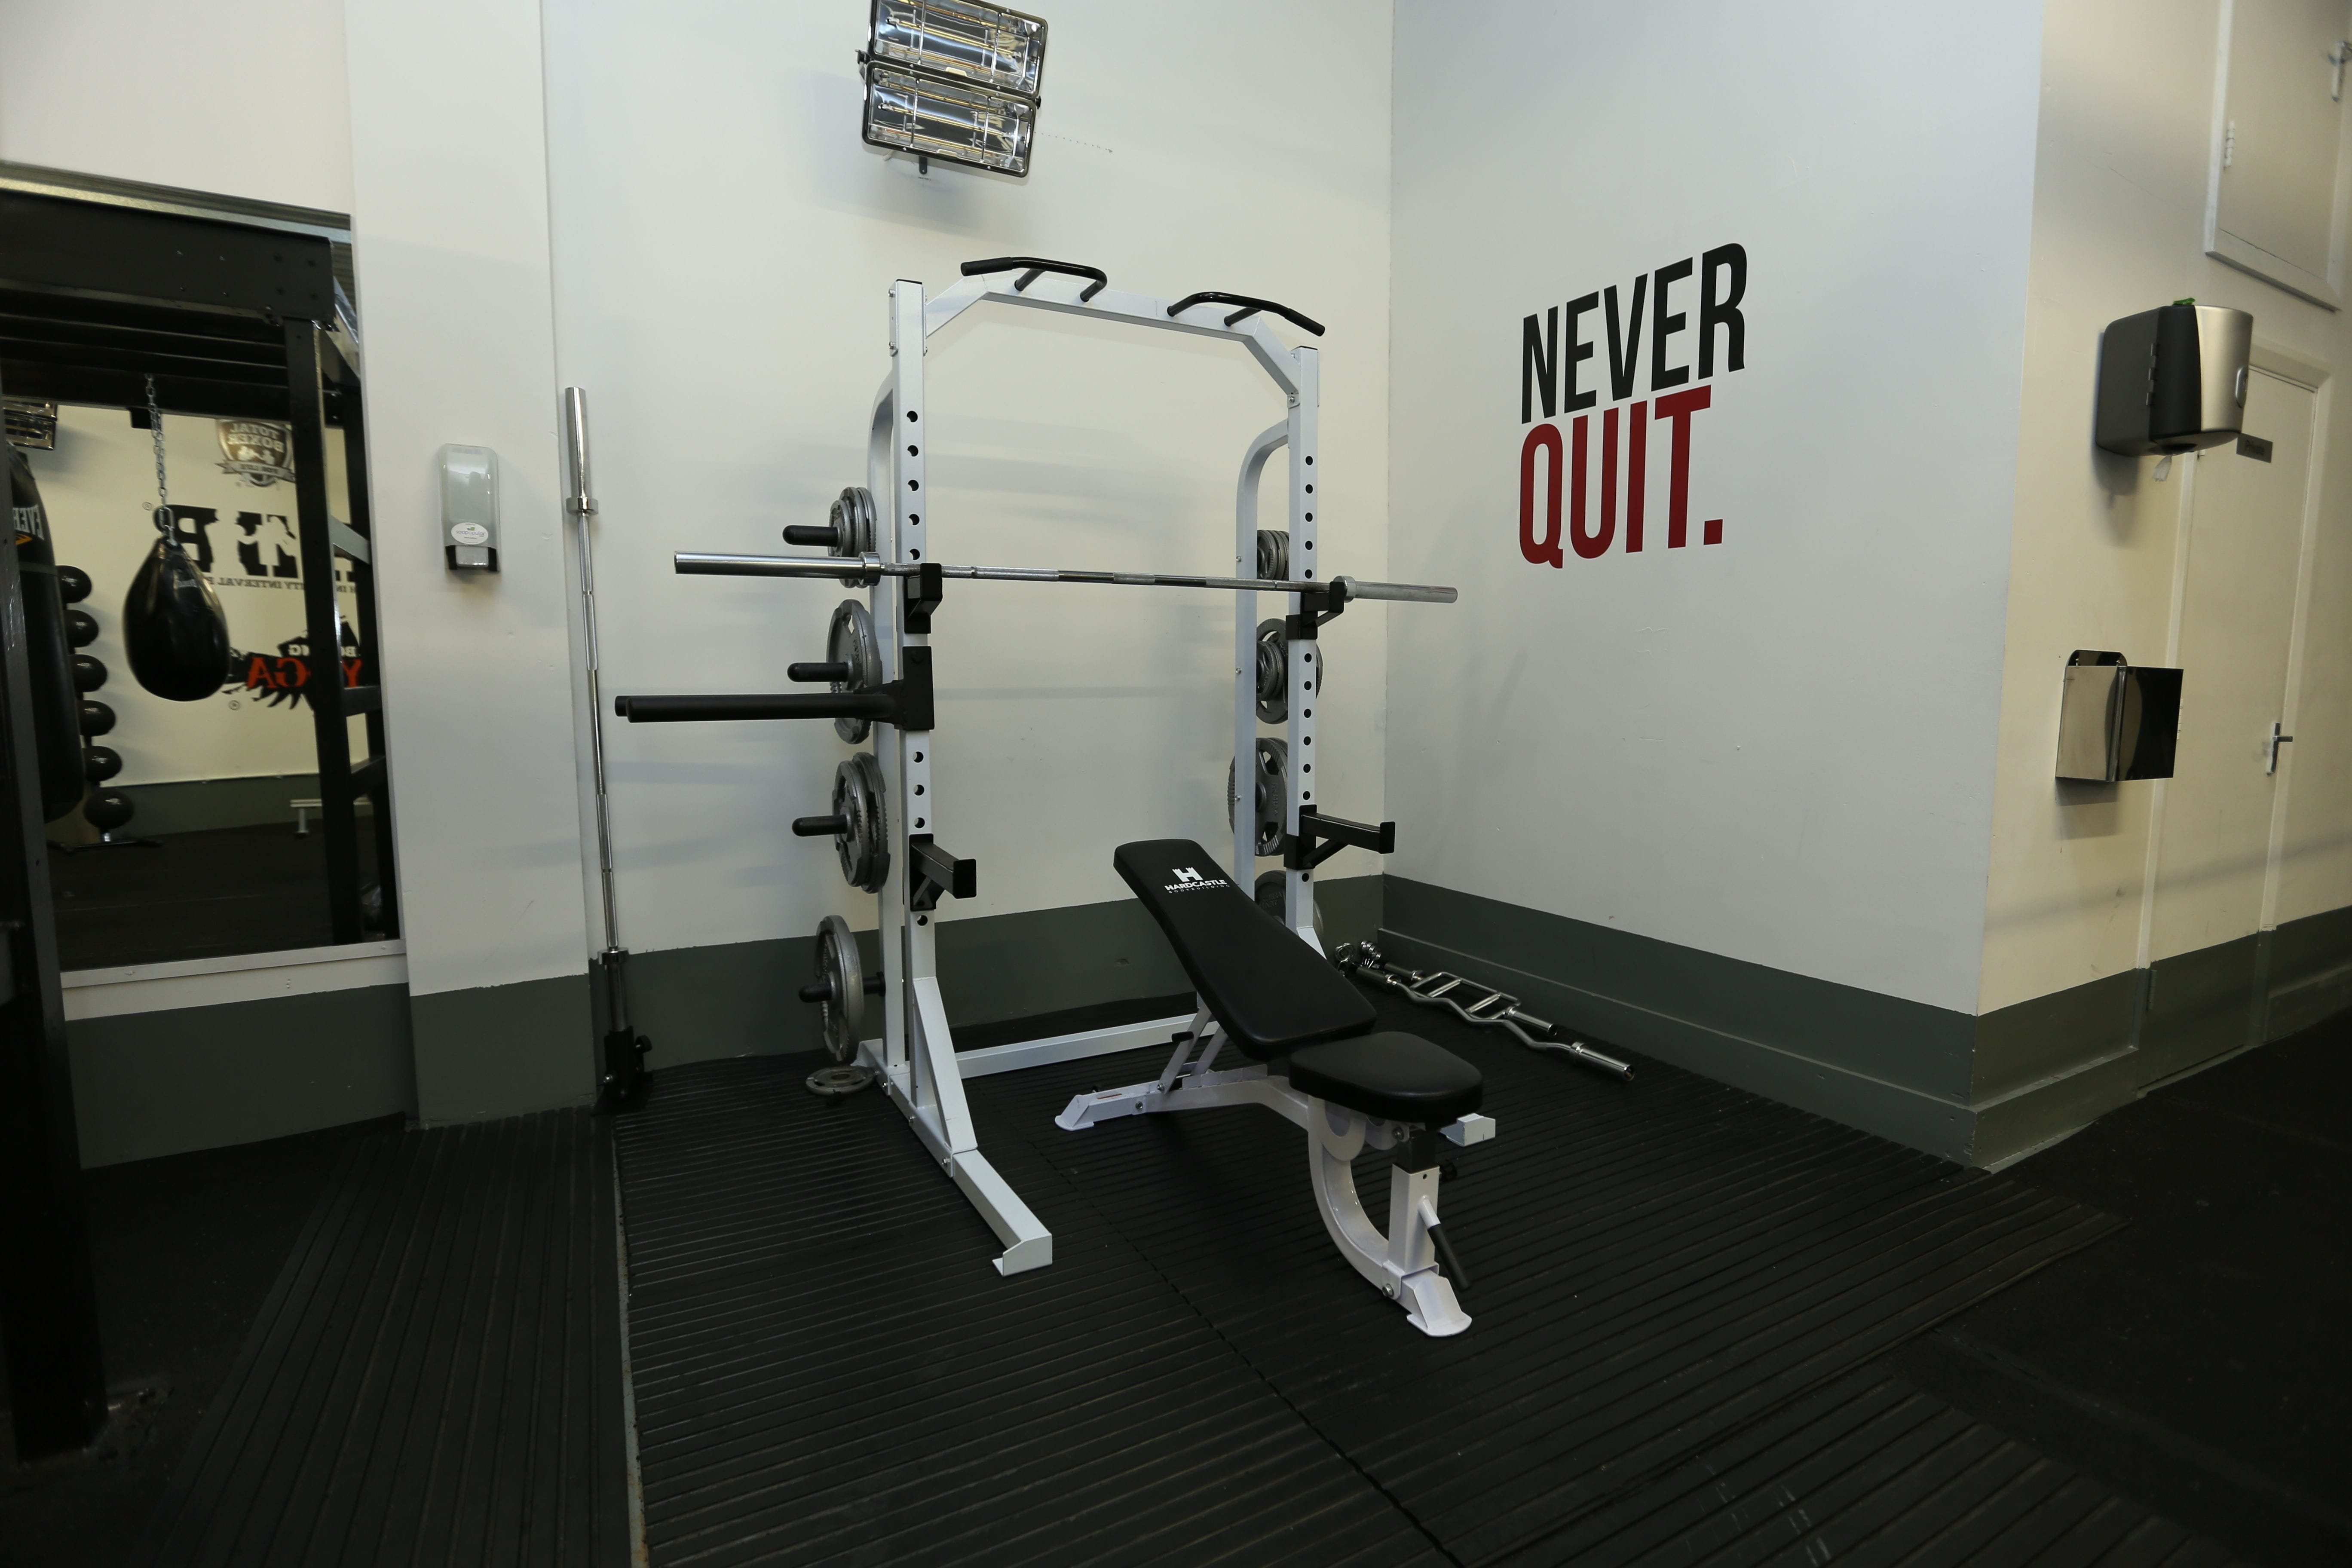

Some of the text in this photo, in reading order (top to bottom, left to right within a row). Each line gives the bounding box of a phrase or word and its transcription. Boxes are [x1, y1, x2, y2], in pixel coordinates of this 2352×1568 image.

[1522, 243, 1747, 424] NEVER
[1519, 384, 1723, 569] QUIT.
[1164, 879, 1227, 891] HARDCASTLE
[1169, 885, 1230, 894] BODYBUILDING
